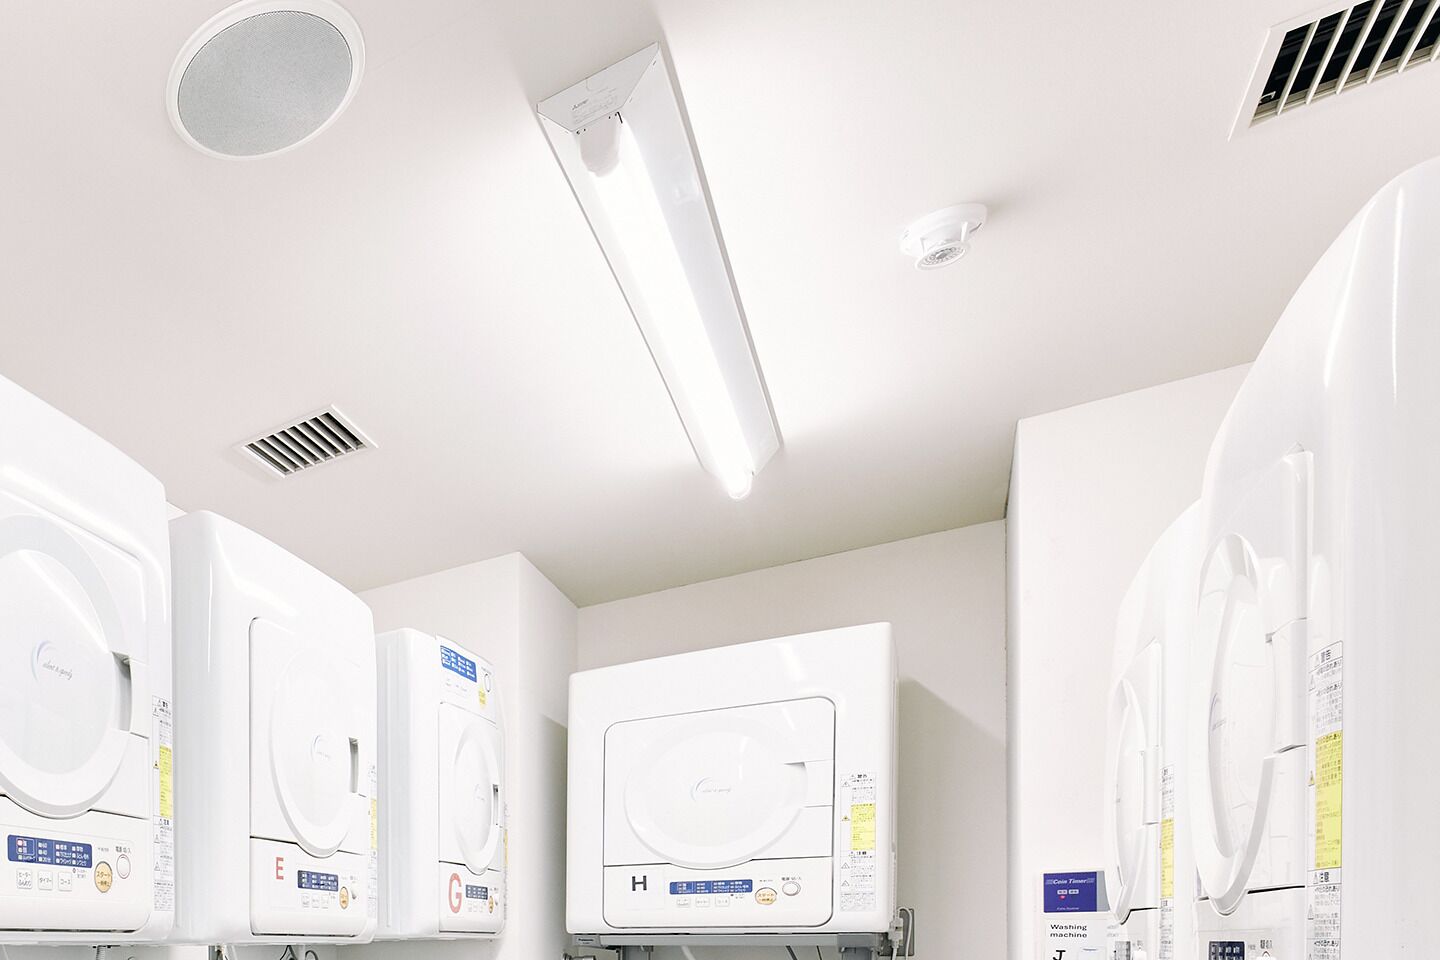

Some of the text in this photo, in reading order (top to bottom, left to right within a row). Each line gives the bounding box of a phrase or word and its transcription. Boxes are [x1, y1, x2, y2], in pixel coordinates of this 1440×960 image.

[275, 857, 285, 880] E
[448, 872, 463, 914] G
[631, 875, 648, 892] H
